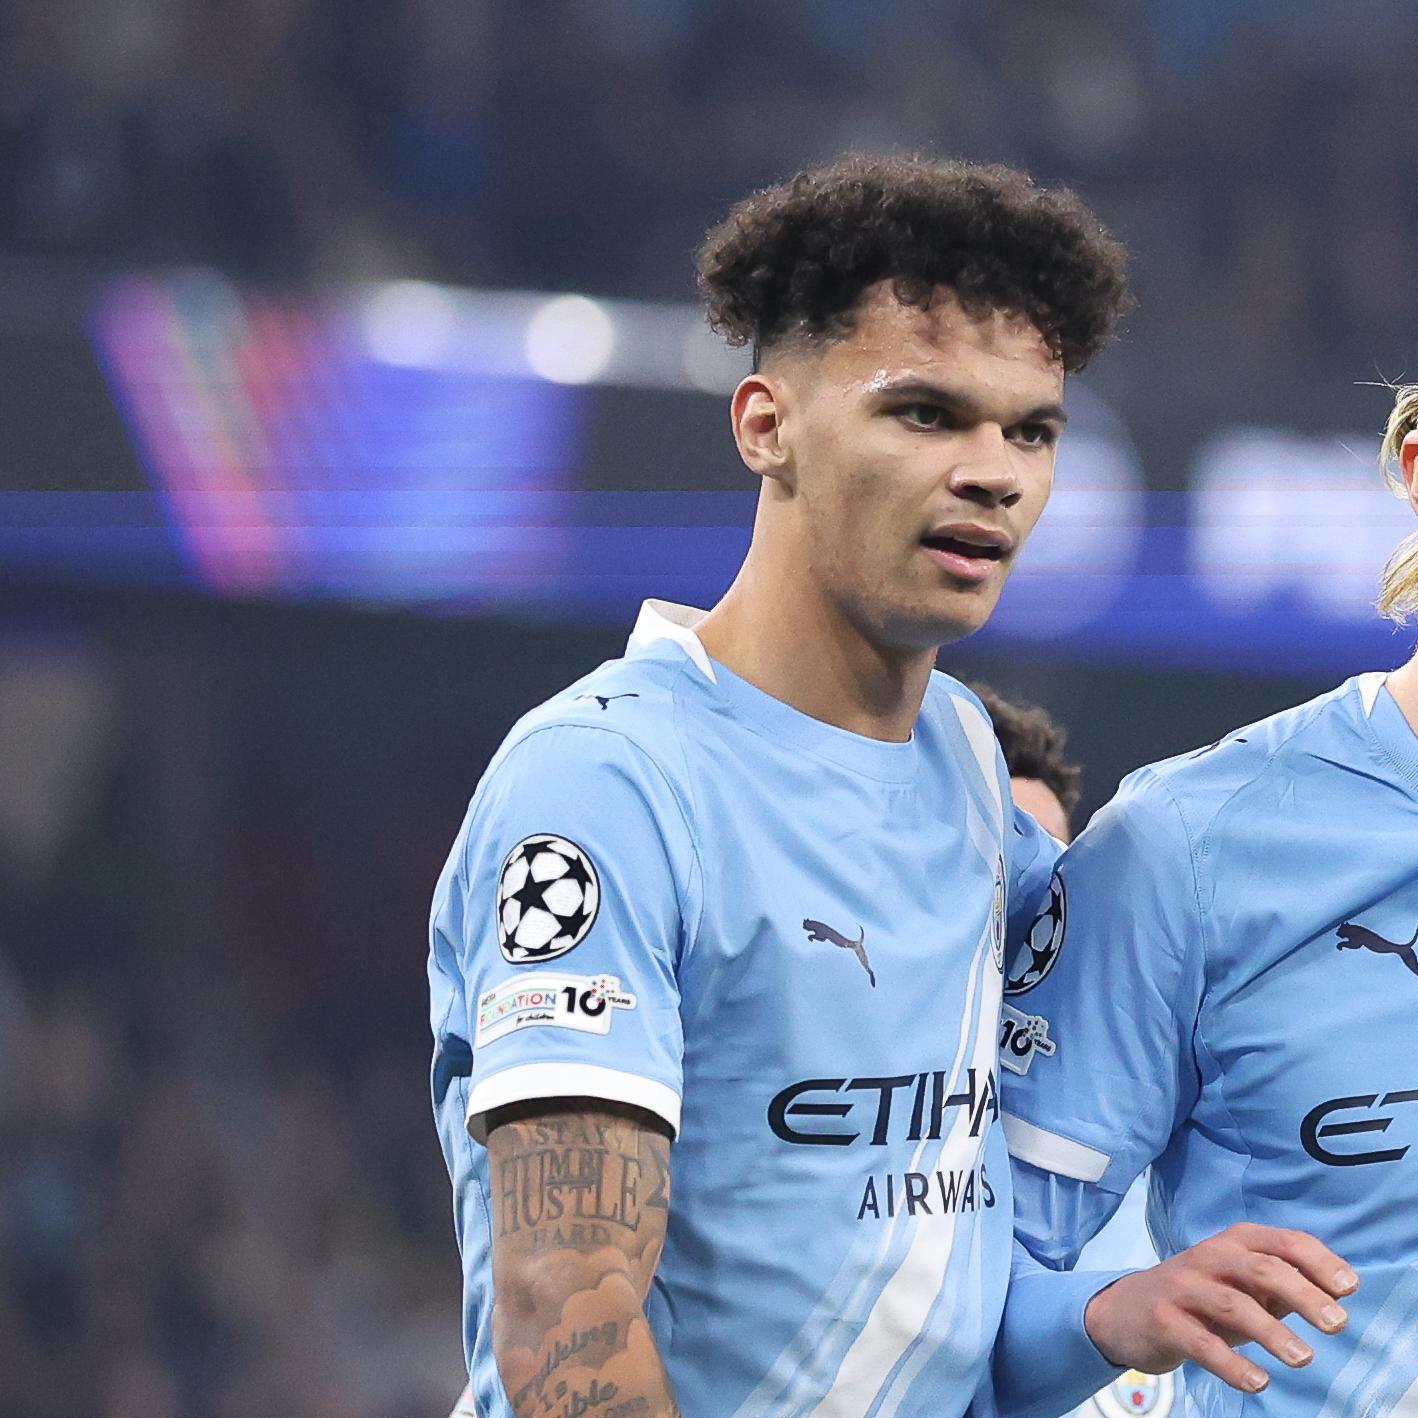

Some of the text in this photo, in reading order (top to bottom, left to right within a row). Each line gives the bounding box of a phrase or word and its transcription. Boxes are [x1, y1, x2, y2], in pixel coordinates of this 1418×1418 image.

[561, 986, 607, 1016] 10
[1001, 1019, 1033, 1057] 10
[857, 1163, 996, 1220] AIRWAS
